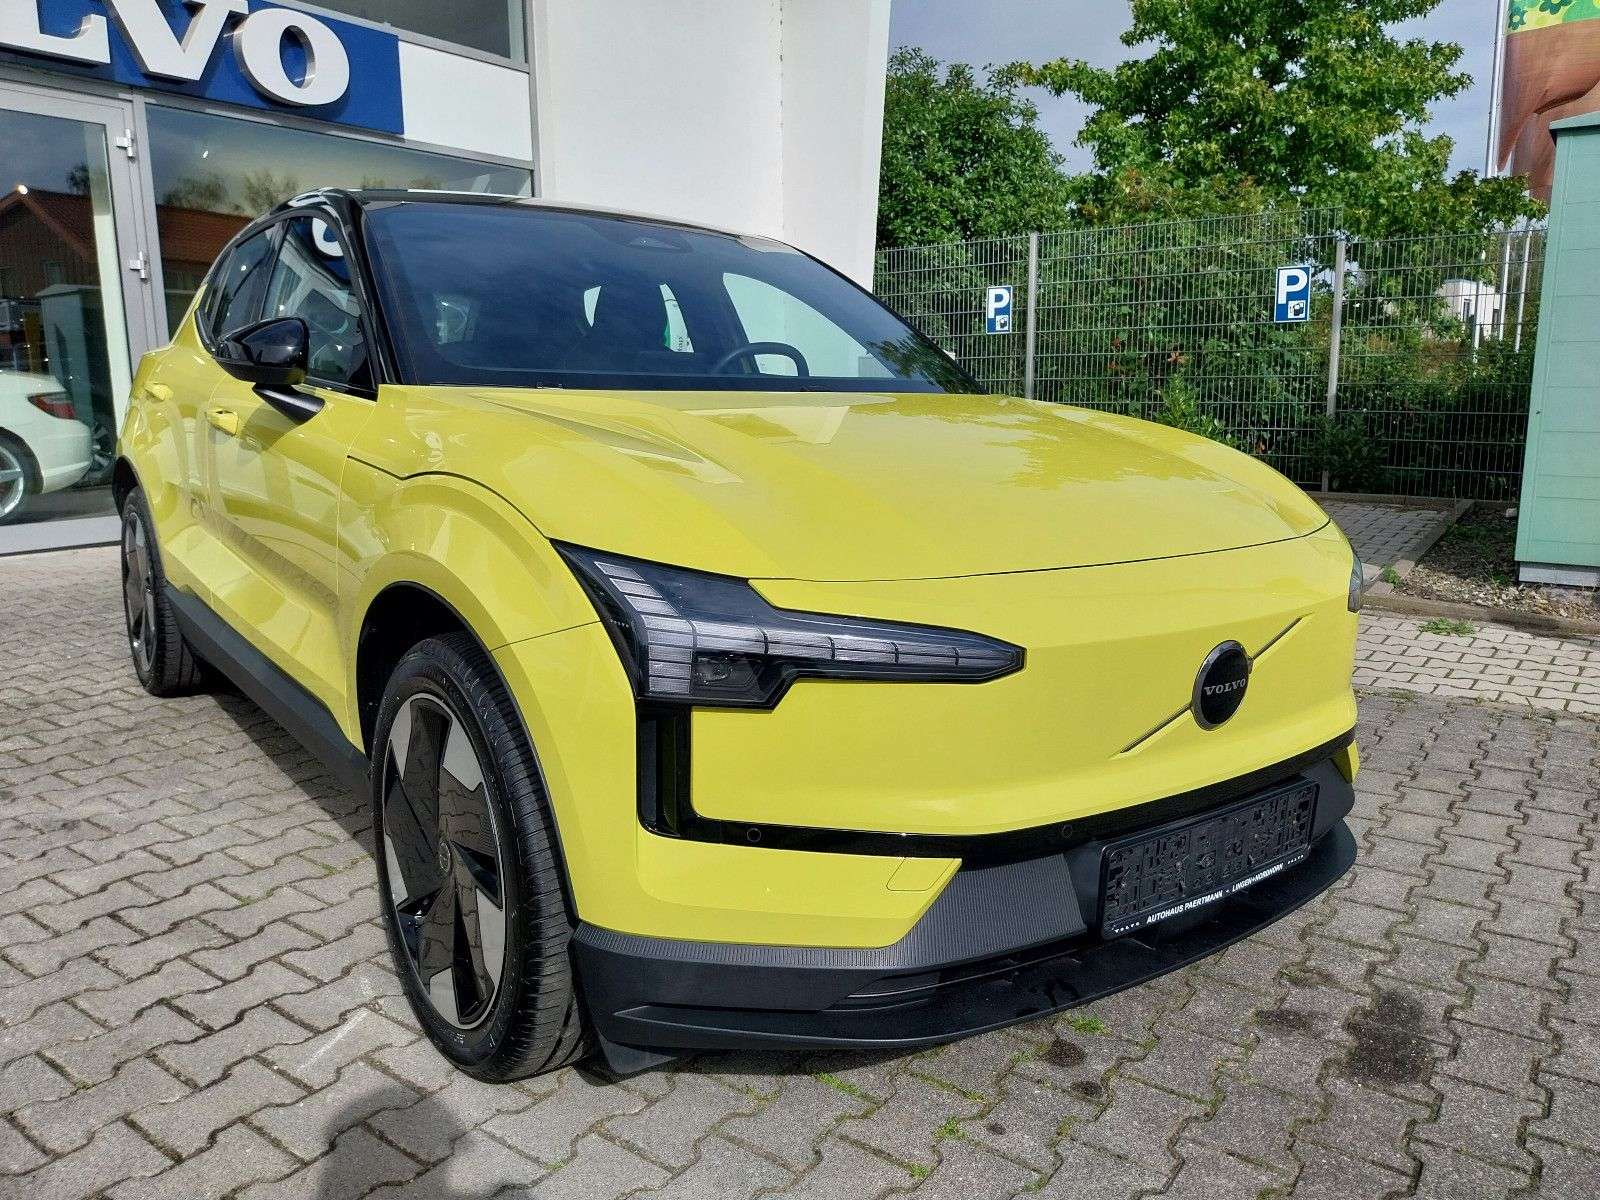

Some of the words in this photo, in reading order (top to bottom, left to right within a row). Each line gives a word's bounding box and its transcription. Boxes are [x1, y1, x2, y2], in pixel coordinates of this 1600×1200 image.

[1277, 269, 1308, 305] P
[988, 288, 1010, 319] P
[1203, 678, 1246, 696] VOLVO
[1146, 905, 1184, 924] AUTOHAUS
